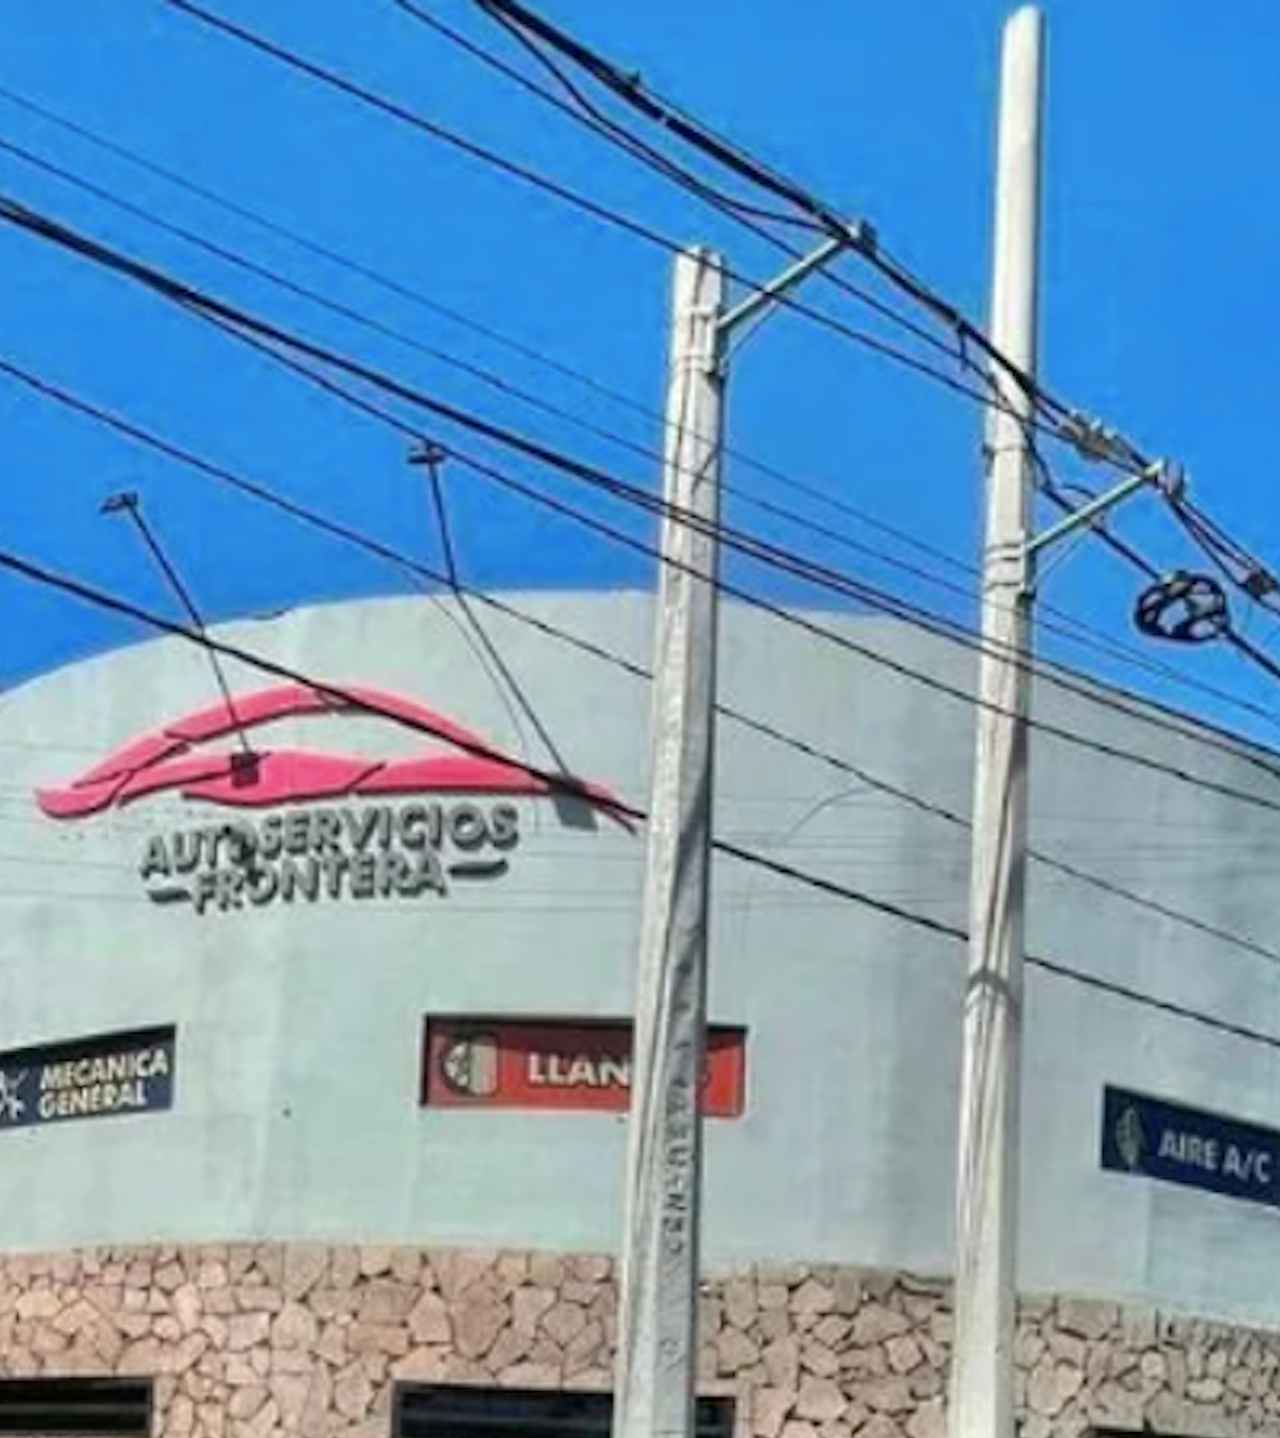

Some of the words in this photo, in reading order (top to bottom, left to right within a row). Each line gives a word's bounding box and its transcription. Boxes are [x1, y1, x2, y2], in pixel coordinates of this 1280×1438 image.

[140, 803, 520, 880] AUTOSERVICIOS
[194, 842, 449, 915] FRONTERA
[526, 1051, 632, 1089] LLAN
[38, 1079, 147, 1119] GENERAL
[1157, 1129, 1219, 1171] AIRE
[1222, 1143, 1272, 1184] A/C
